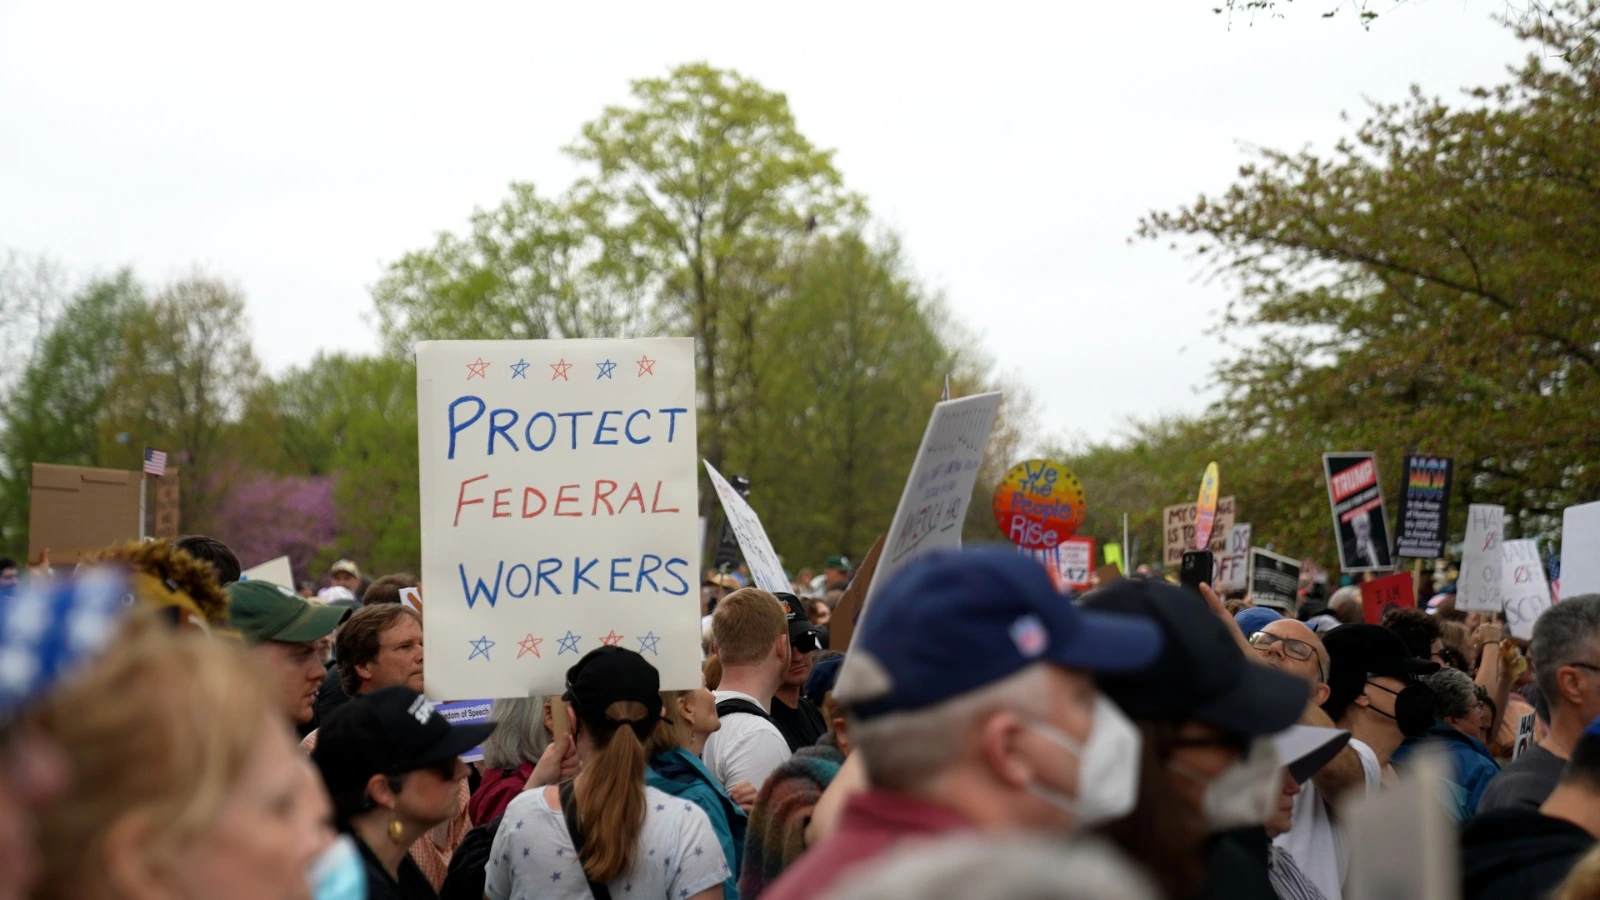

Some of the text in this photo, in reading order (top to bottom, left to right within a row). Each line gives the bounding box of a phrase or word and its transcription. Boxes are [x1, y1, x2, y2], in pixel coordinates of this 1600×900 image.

[448, 395, 687, 460] PROTECT
[1025, 462, 1057, 483] We
[1332, 458, 1373, 497] TRUMP
[1407, 457, 1447, 500] NO!
[453, 474, 679, 527] FEDERAL
[1019, 479, 1052, 497] The
[1011, 491, 1071, 524] People
[1168, 508, 1188, 524] MY
[1010, 514, 1058, 547] Rise
[1168, 528, 1178, 543] IS
[459, 554, 689, 610] WORKERS
[1063, 567, 1086, 580] 47
[1376, 584, 1400, 605] I AM
[462, 710, 467, 718] of
[468, 708, 489, 718] Speech
